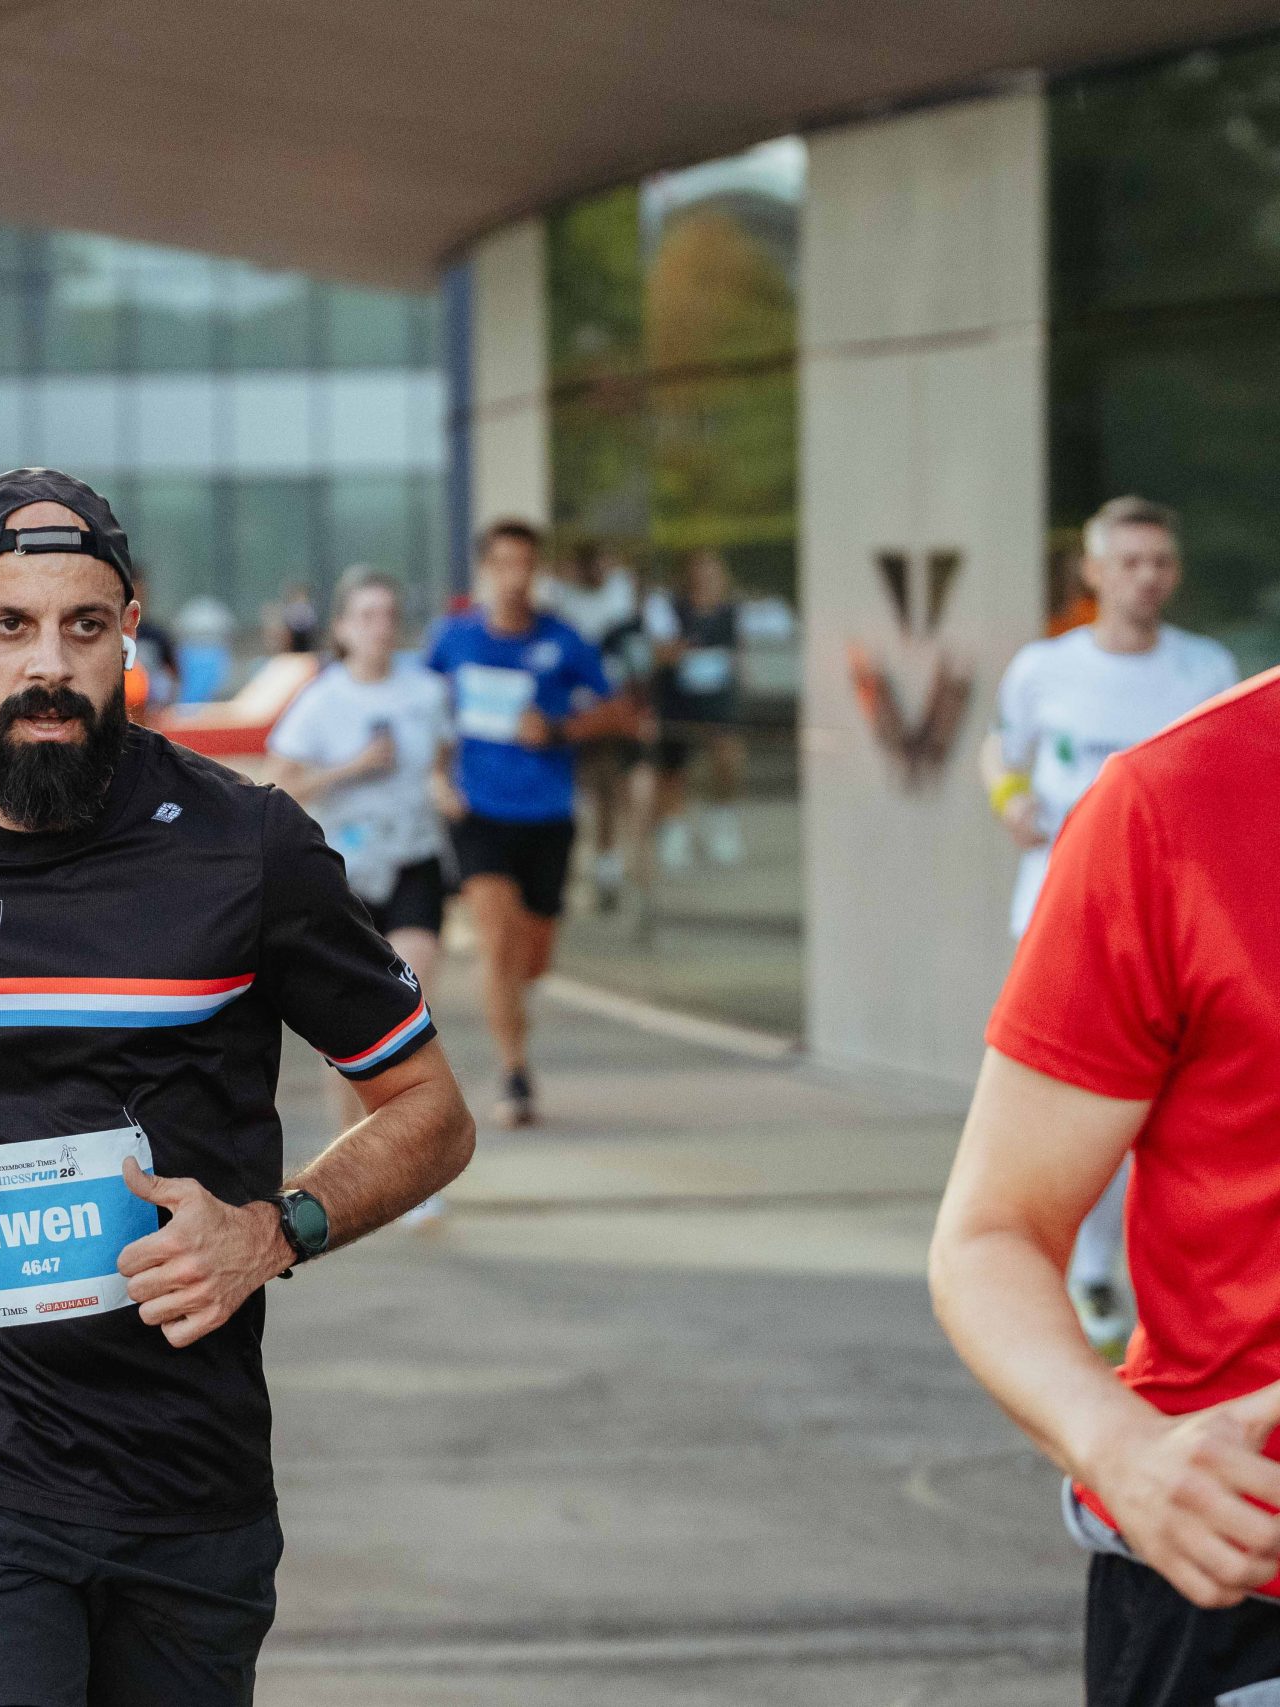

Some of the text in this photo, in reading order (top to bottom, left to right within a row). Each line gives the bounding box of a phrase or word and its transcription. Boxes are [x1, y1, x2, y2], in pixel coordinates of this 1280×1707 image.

[36, 1159, 57, 1168] TIMES
[59, 1167, 76, 1178] 26
[21, 1257, 61, 1277] 4647
[45, 1296, 98, 1311] BAUHAUS
[0, 1306, 28, 1317] TIMES
